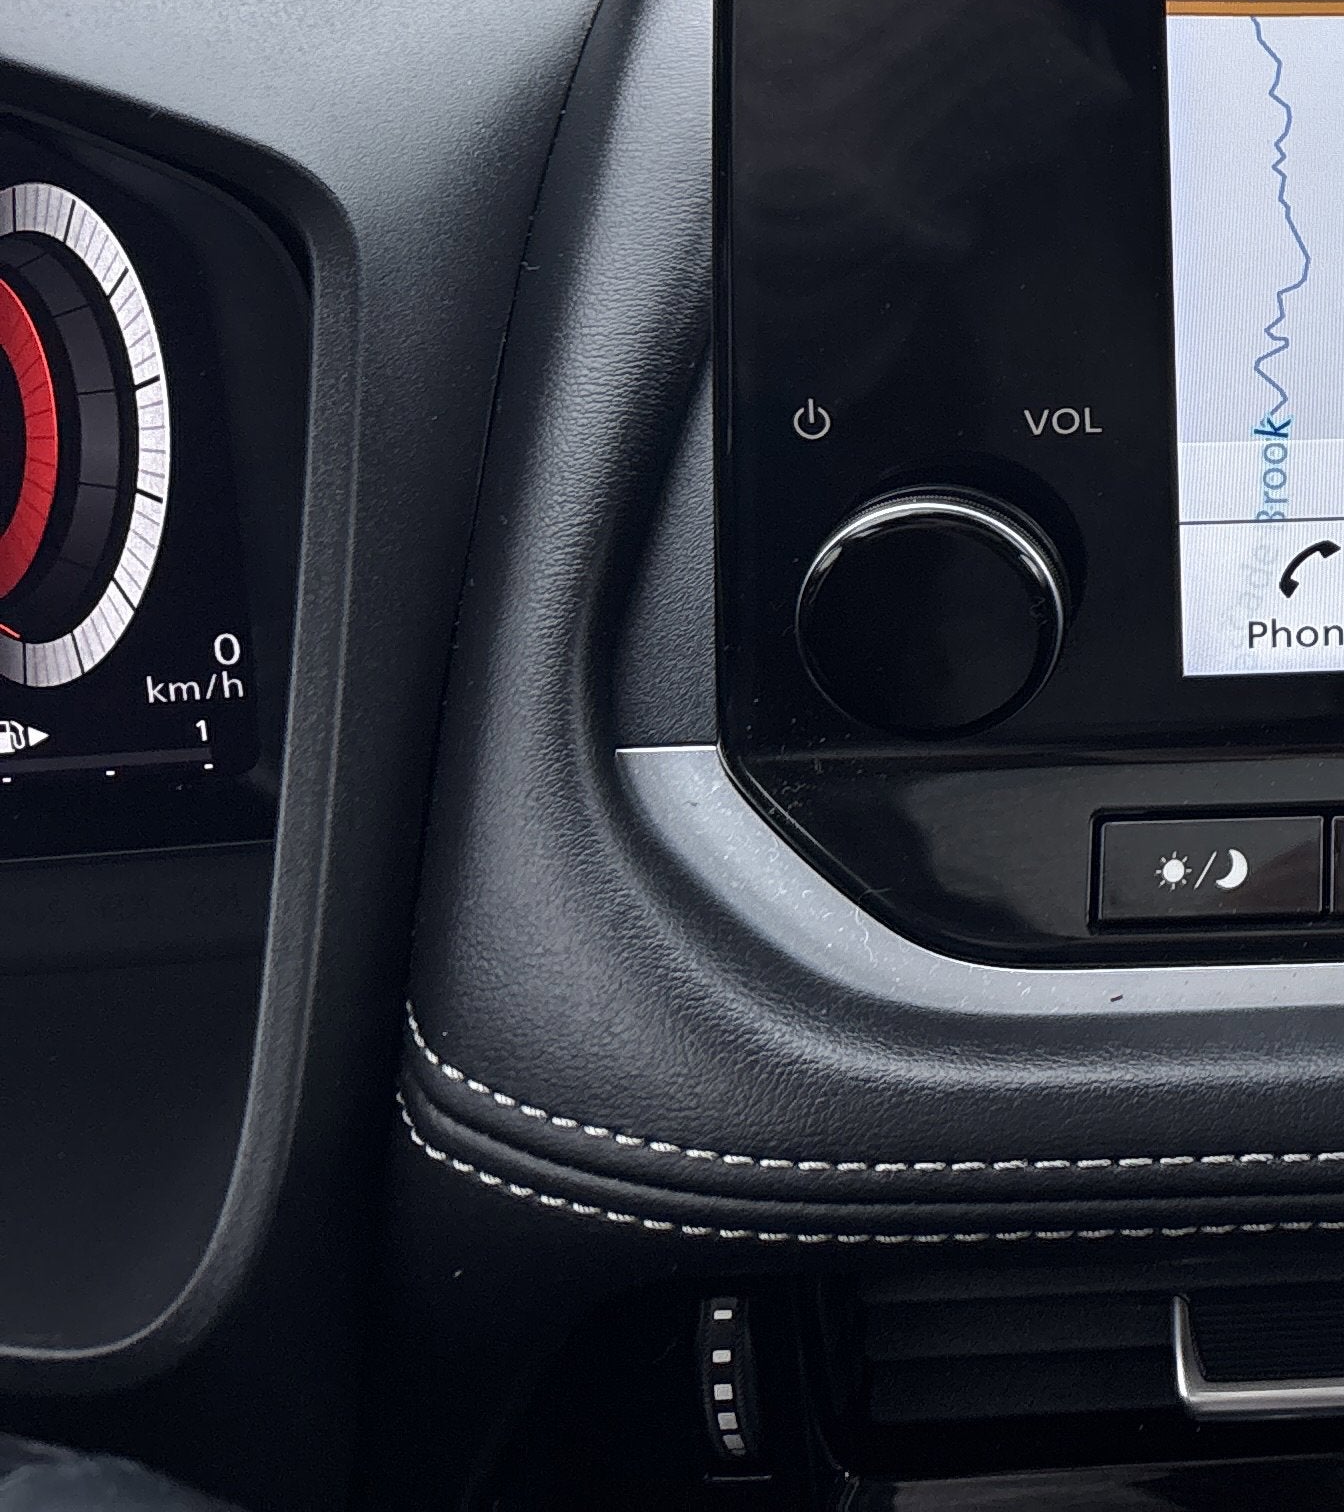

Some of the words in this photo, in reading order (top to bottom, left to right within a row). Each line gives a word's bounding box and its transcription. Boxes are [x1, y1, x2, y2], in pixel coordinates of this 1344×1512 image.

[1024, 407, 1103, 436] VOL
[1253, 416, 1292, 522] Brook
[213, 633, 241, 666] 0
[146, 670, 245, 704] km/h
[195, 719, 208, 742] 1
